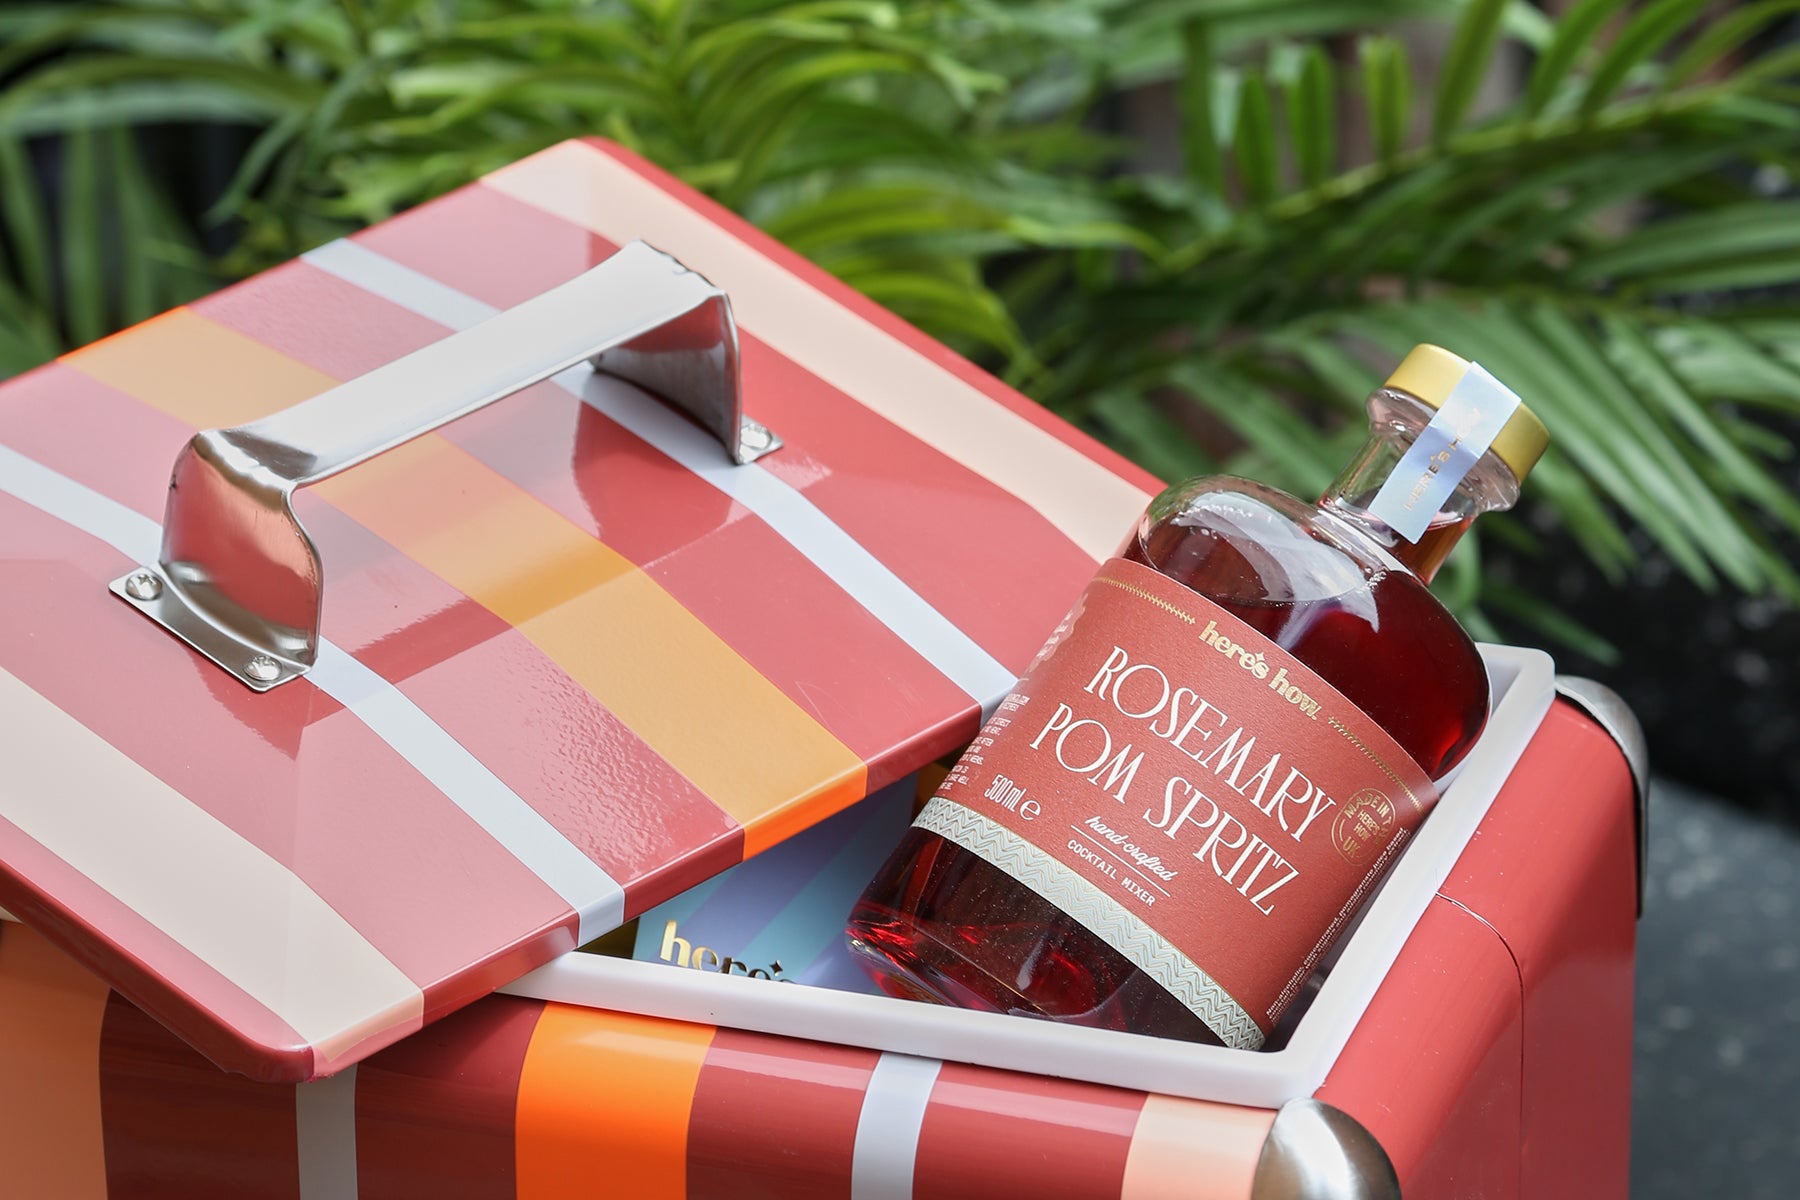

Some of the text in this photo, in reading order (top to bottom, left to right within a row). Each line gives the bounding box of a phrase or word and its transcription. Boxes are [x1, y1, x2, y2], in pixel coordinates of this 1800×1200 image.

[1083, 645, 1337, 842] ROSEMARY
[1029, 702, 1300, 917] POM SPRITZ
[1344, 793, 1381, 819] MADE
[1376, 801, 1391, 818] IN
[1067, 839, 1156, 907] COCKTAIL MIXER
[1341, 836, 1361, 858] UK
